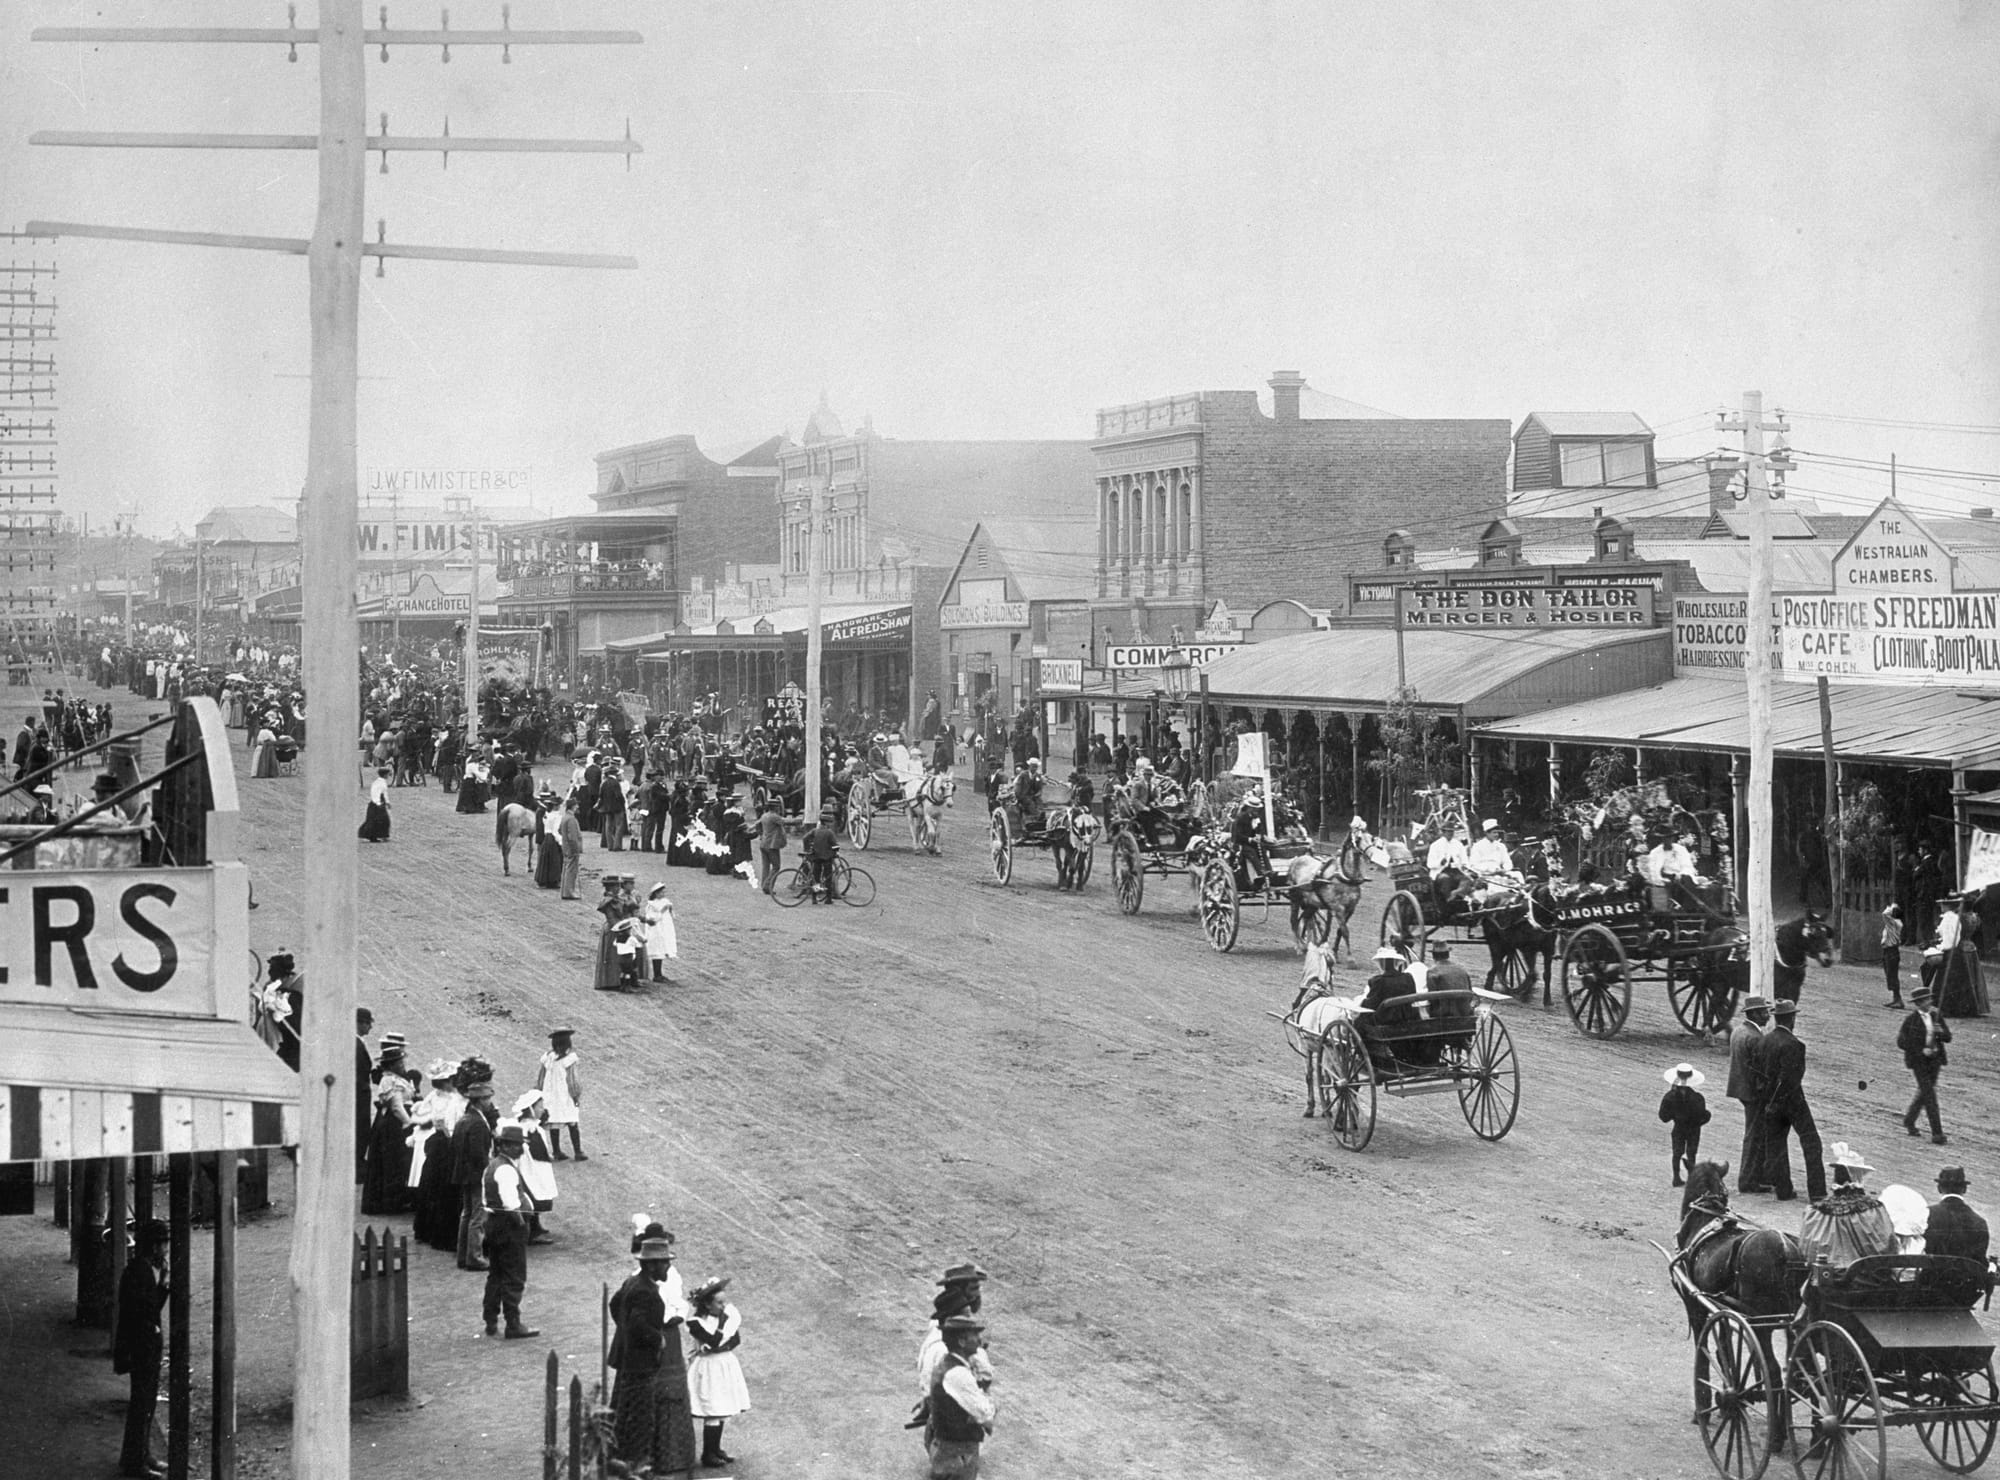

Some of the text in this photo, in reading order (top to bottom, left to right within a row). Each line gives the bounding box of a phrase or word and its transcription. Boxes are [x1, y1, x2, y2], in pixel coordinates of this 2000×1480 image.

[1879, 520, 1901, 535] THE
[1854, 544, 1928, 560] WESTRALIAN
[1849, 568, 1938, 584] CHAMBERS.
[1412, 589, 1639, 610] THE DON TAILOR
[1676, 600, 1735, 619] WHOLESALE
[827, 615, 882, 630] HARDWARE
[1406, 610, 1644, 626] MERCER & HOSIER
[1783, 598, 1816, 626] POST
[1820, 598, 1869, 627] OFFICE
[1801, 633, 1850, 655] CAFE
[1873, 635, 1929, 671] CLOTHING
[1681, 648, 1745, 668] HAIRDRESSING
[1041, 663, 1081, 685] BRICKNELL
[0, 881, 178, 993] RS
